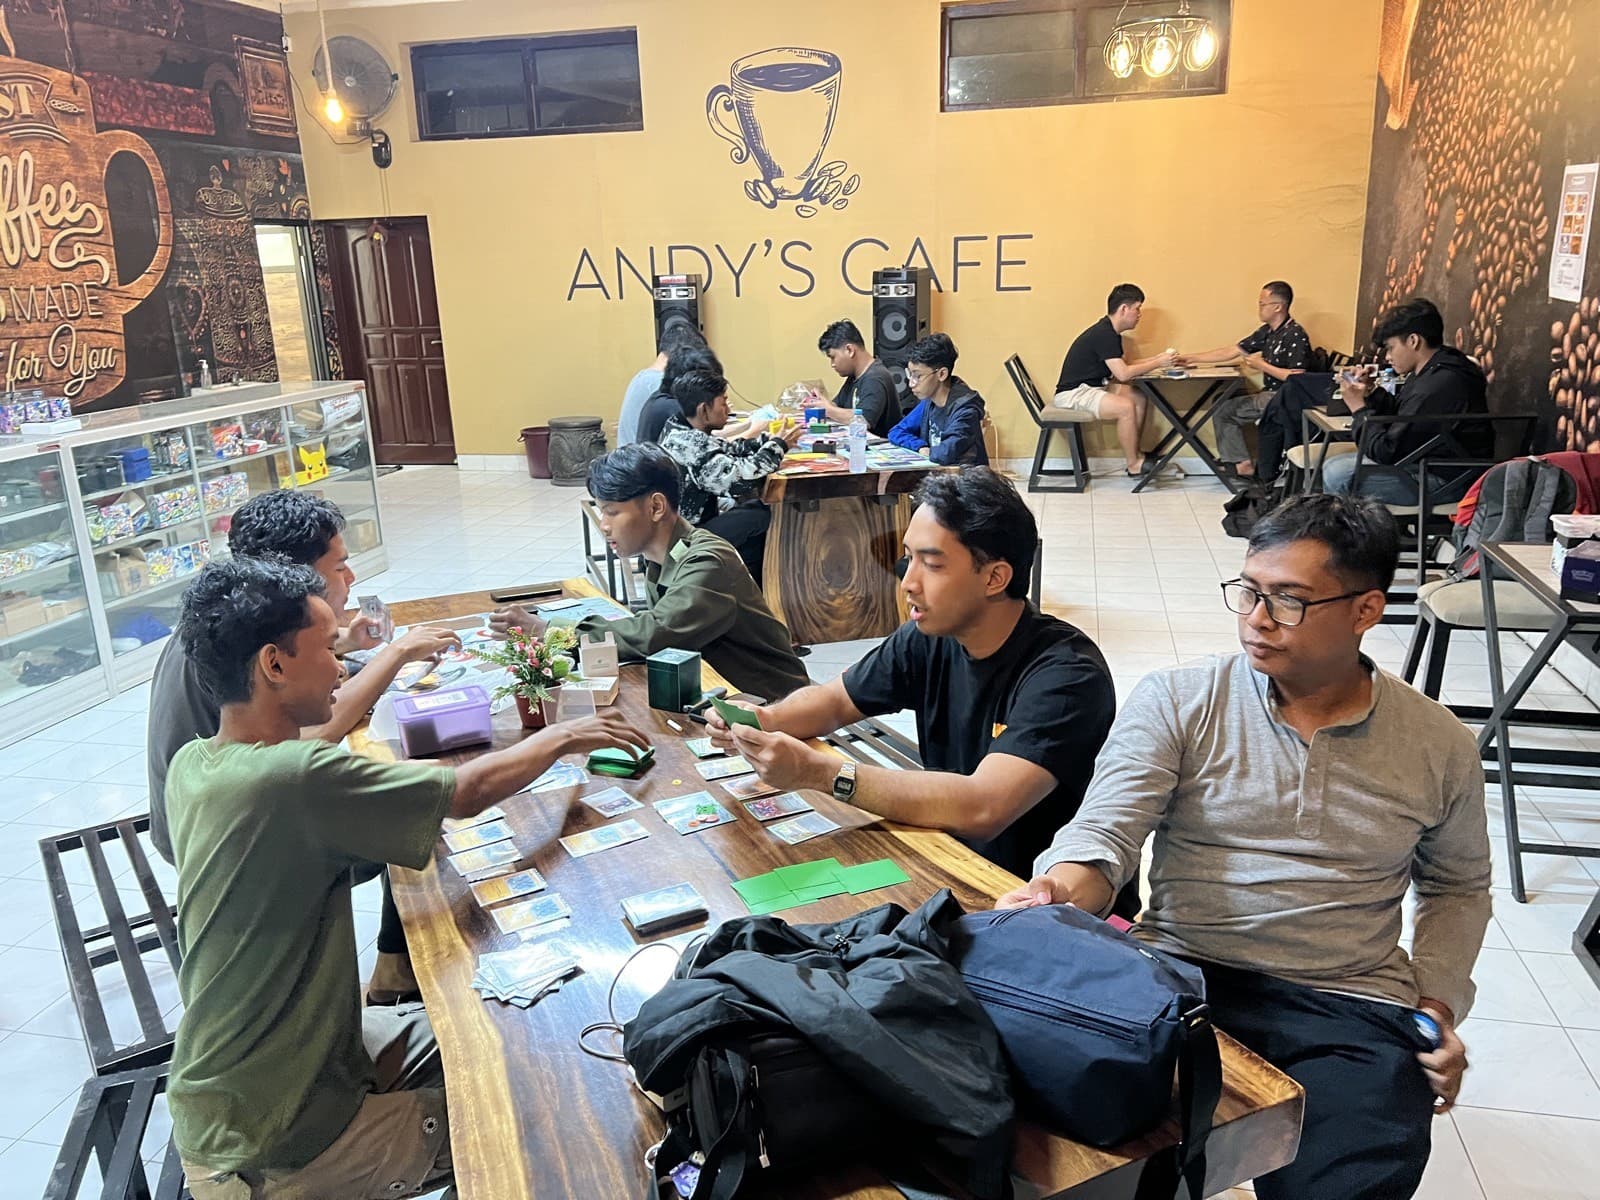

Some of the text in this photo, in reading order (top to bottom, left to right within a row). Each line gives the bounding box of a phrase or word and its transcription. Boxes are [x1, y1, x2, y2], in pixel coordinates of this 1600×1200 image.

[567, 234, 1034, 301] ANDY'S CAFE
[6, 323, 117, 397] for You
